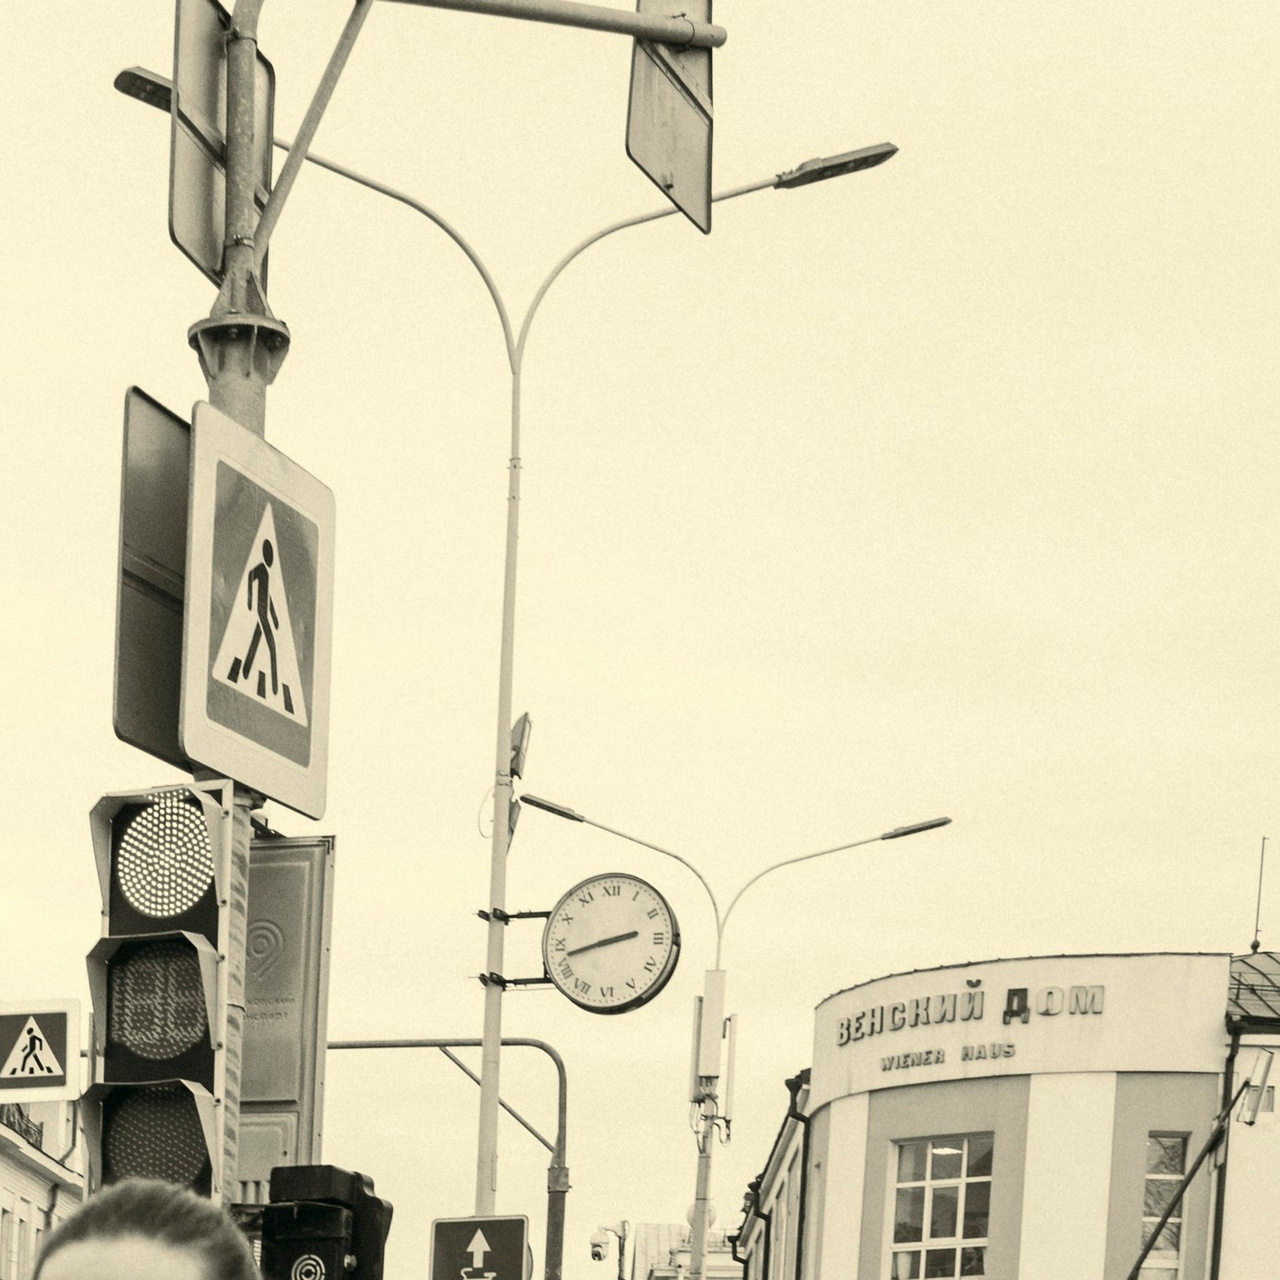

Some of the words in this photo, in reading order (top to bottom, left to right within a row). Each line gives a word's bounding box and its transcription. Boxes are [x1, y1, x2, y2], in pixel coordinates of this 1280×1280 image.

[603, 885, 620, 897] XII
[632, 890, 640, 902] I
[579, 892, 594, 908] XI
[562, 913, 573, 925] X
[646, 908, 659, 920] II
[555, 938, 566, 952] IX
[653, 932, 664, 945] III
[644, 956, 657, 973] IV
[574, 978, 592, 995] VII
[625, 978, 636, 990] V
[600, 987, 614, 998] VI
[836, 979, 985, 1047] ВЕНСКИЙ
[1002, 985, 1105, 1025] ДОМ
[880, 1049, 945, 1071] WIENER
[961, 1043, 1016, 1062] HAUS
